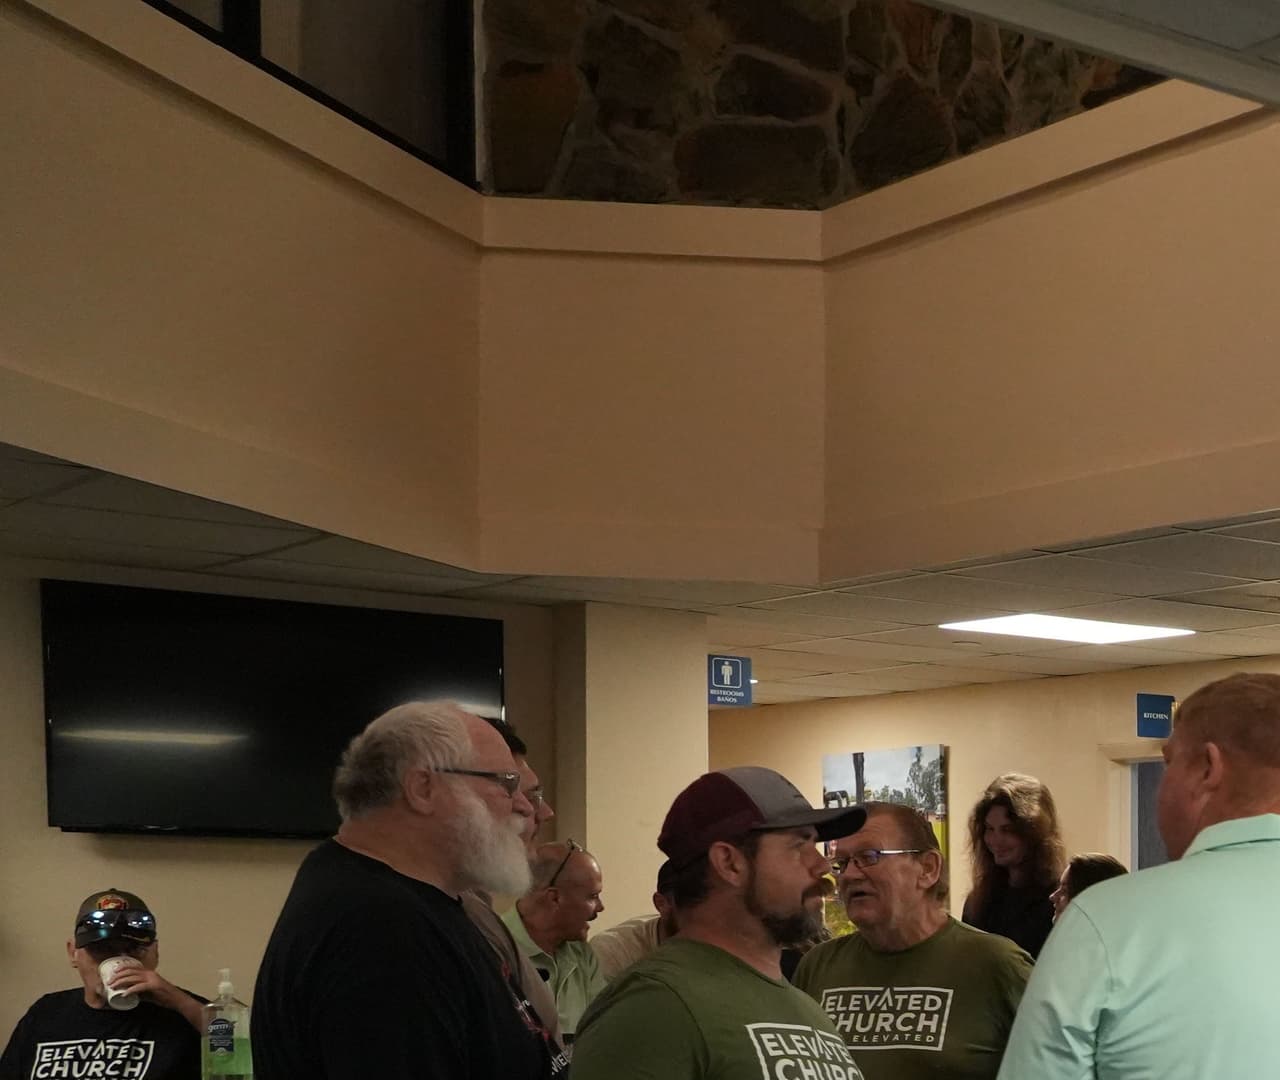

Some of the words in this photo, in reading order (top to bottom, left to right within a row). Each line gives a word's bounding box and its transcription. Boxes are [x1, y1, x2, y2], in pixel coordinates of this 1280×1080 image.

[825, 987, 943, 1011] ELEVATED
[760, 1029, 856, 1065] ELEVATE
[852, 1034, 935, 1043] ELEVATED
[40, 1040, 146, 1063] ELEVATED
[36, 1060, 143, 1079] CHURCH
